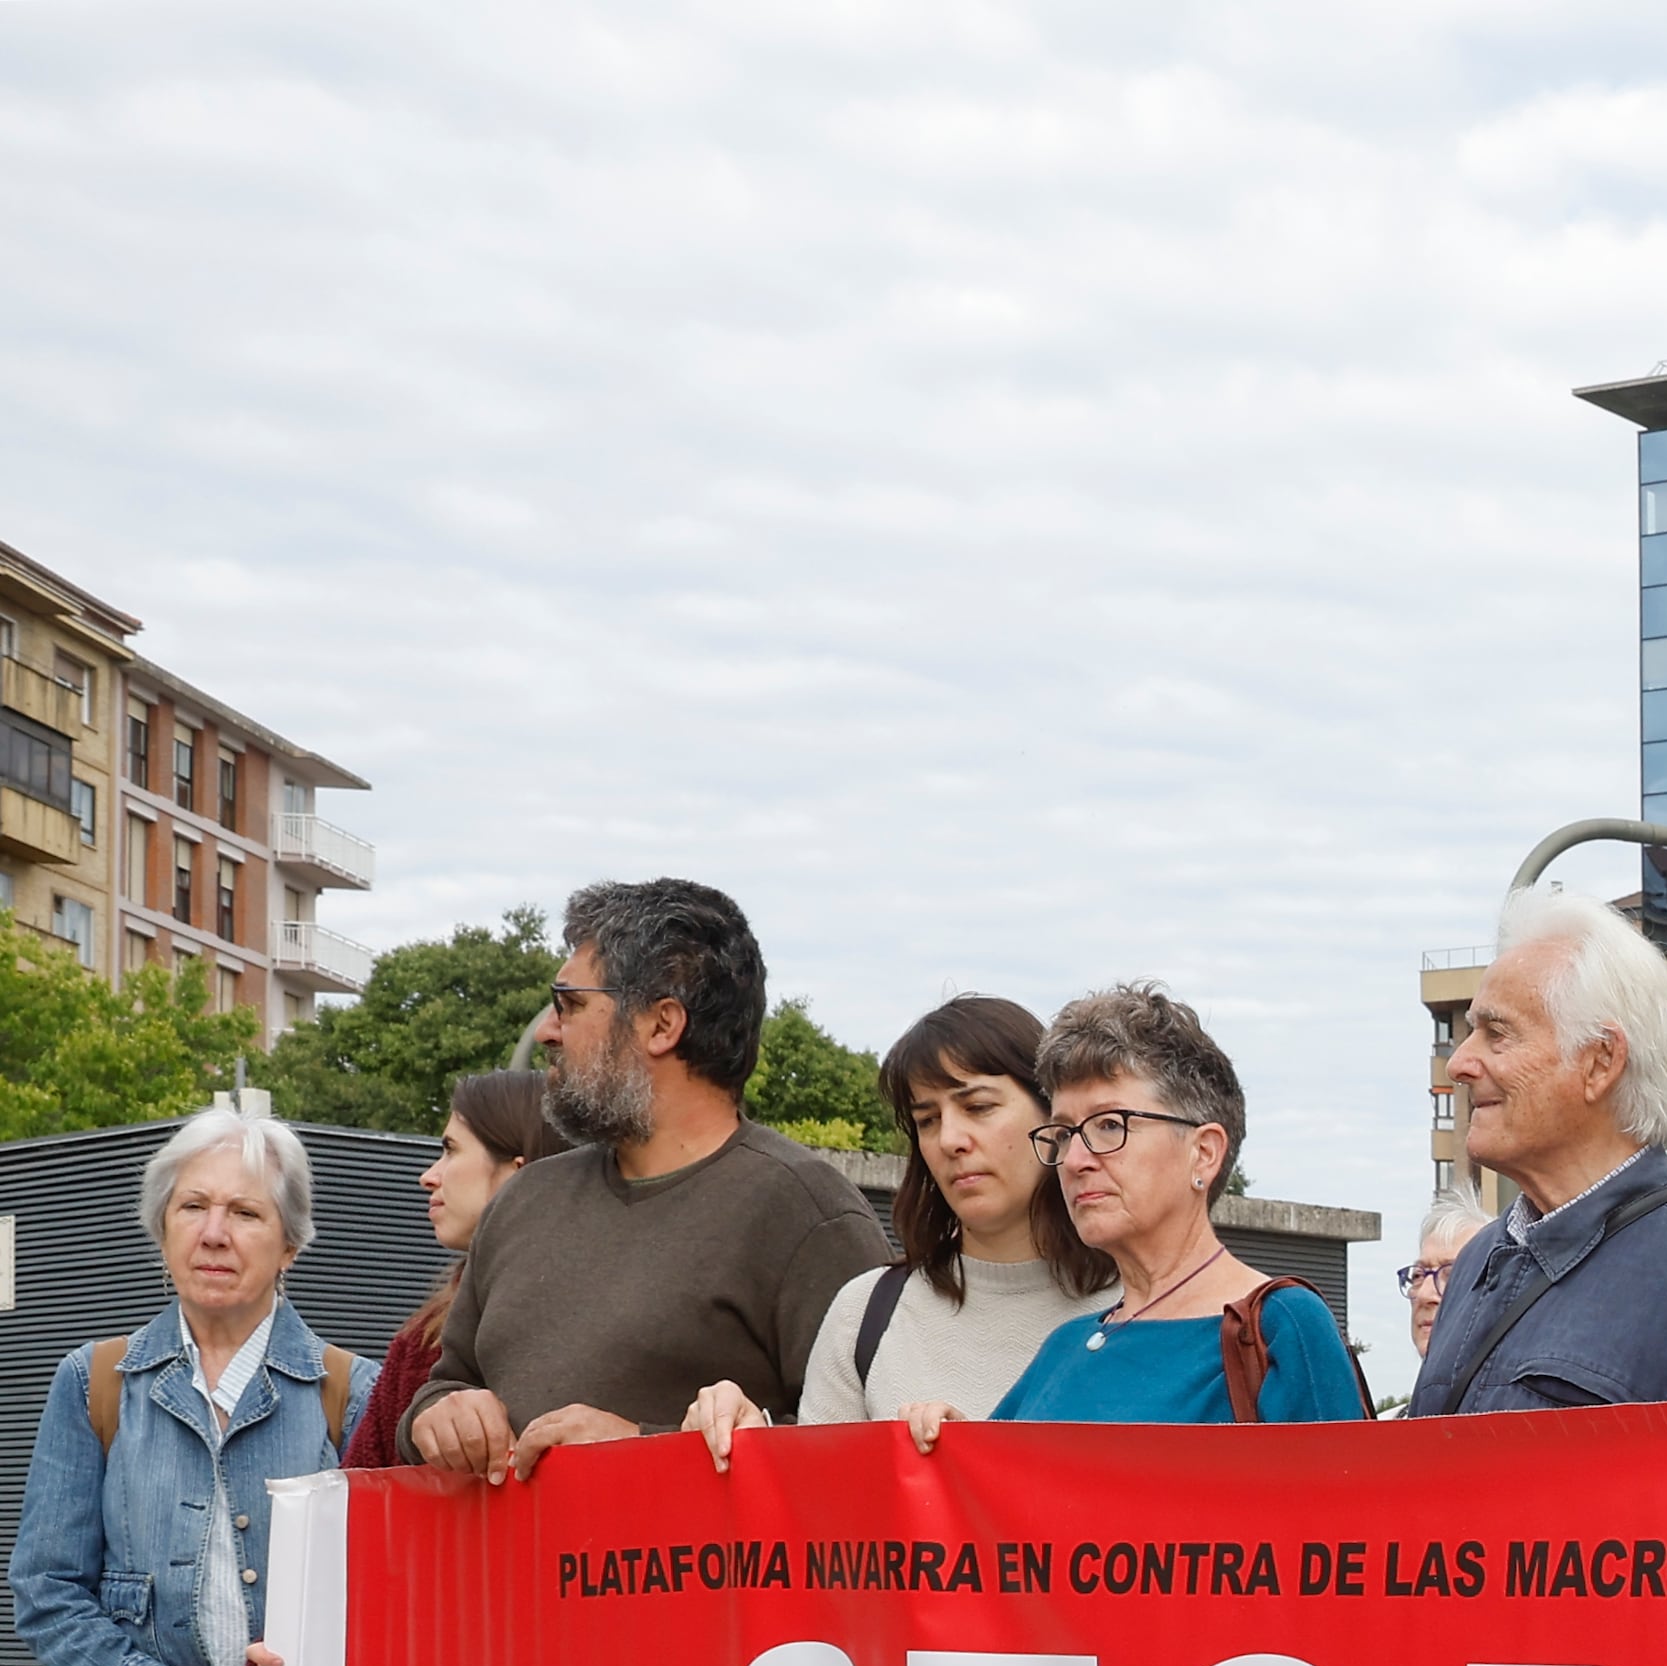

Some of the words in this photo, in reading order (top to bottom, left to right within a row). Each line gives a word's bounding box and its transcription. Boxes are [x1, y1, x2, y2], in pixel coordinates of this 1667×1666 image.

[559, 1540, 791, 1598] PLATAFOMA
[806, 1541, 983, 1593] NAVARRA
[997, 1542, 1052, 1593] EN
[1070, 1542, 1281, 1596] CONTRA
[1300, 1542, 1367, 1596] DE
[1384, 1540, 1485, 1598] LAS
